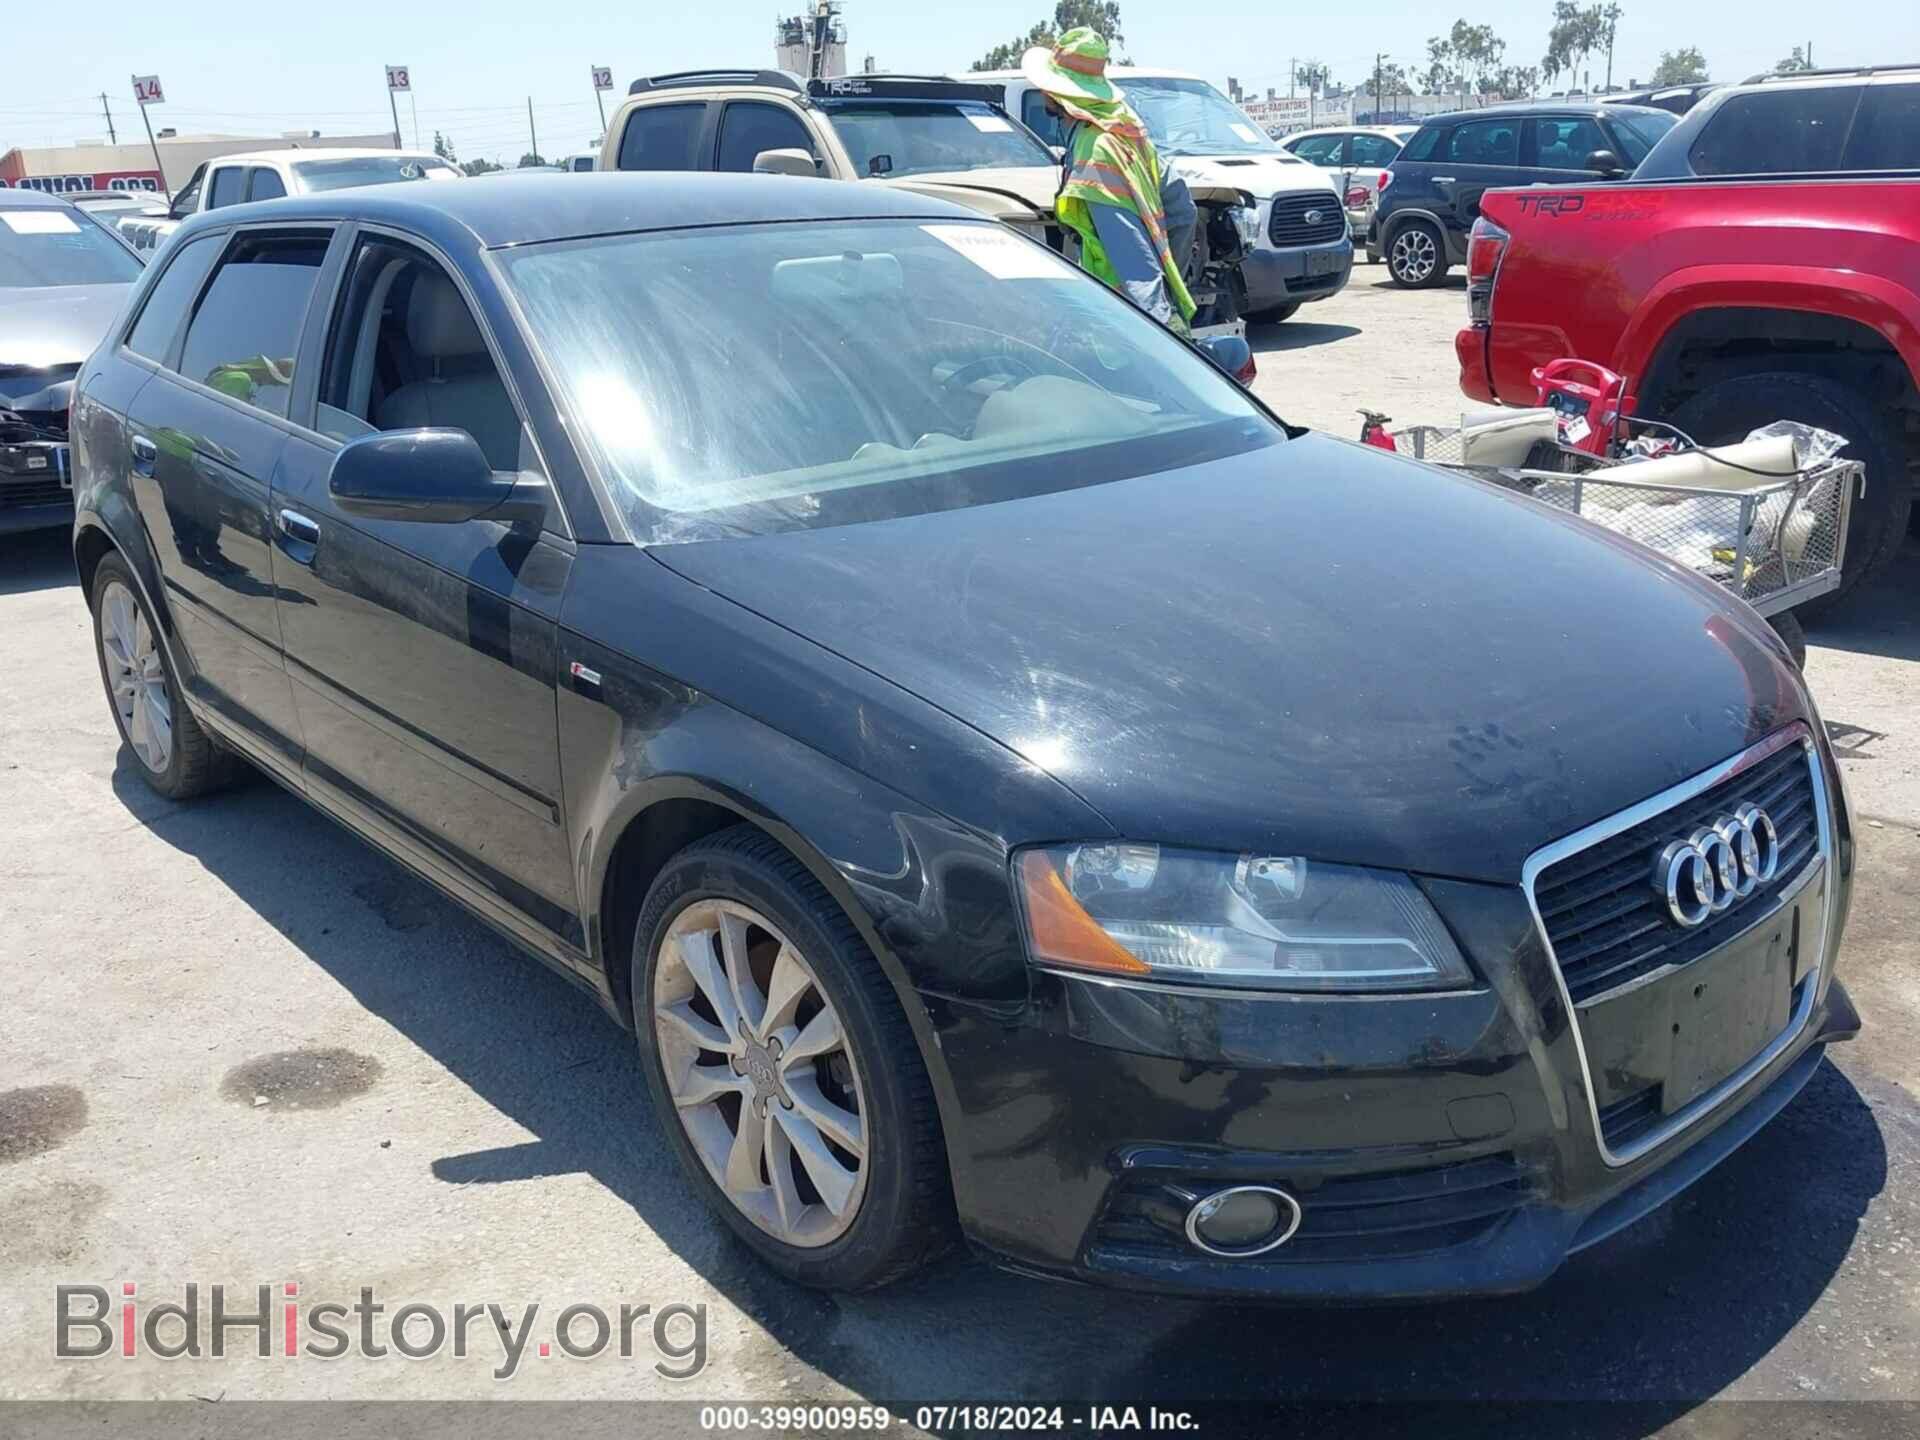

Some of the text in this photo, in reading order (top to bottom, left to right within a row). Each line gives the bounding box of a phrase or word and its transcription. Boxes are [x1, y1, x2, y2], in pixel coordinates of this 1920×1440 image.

[387, 70, 408, 87] 13
[593, 71, 613, 87] 12
[133, 80, 162, 101] 14
[1516, 195, 1585, 217] TRD
